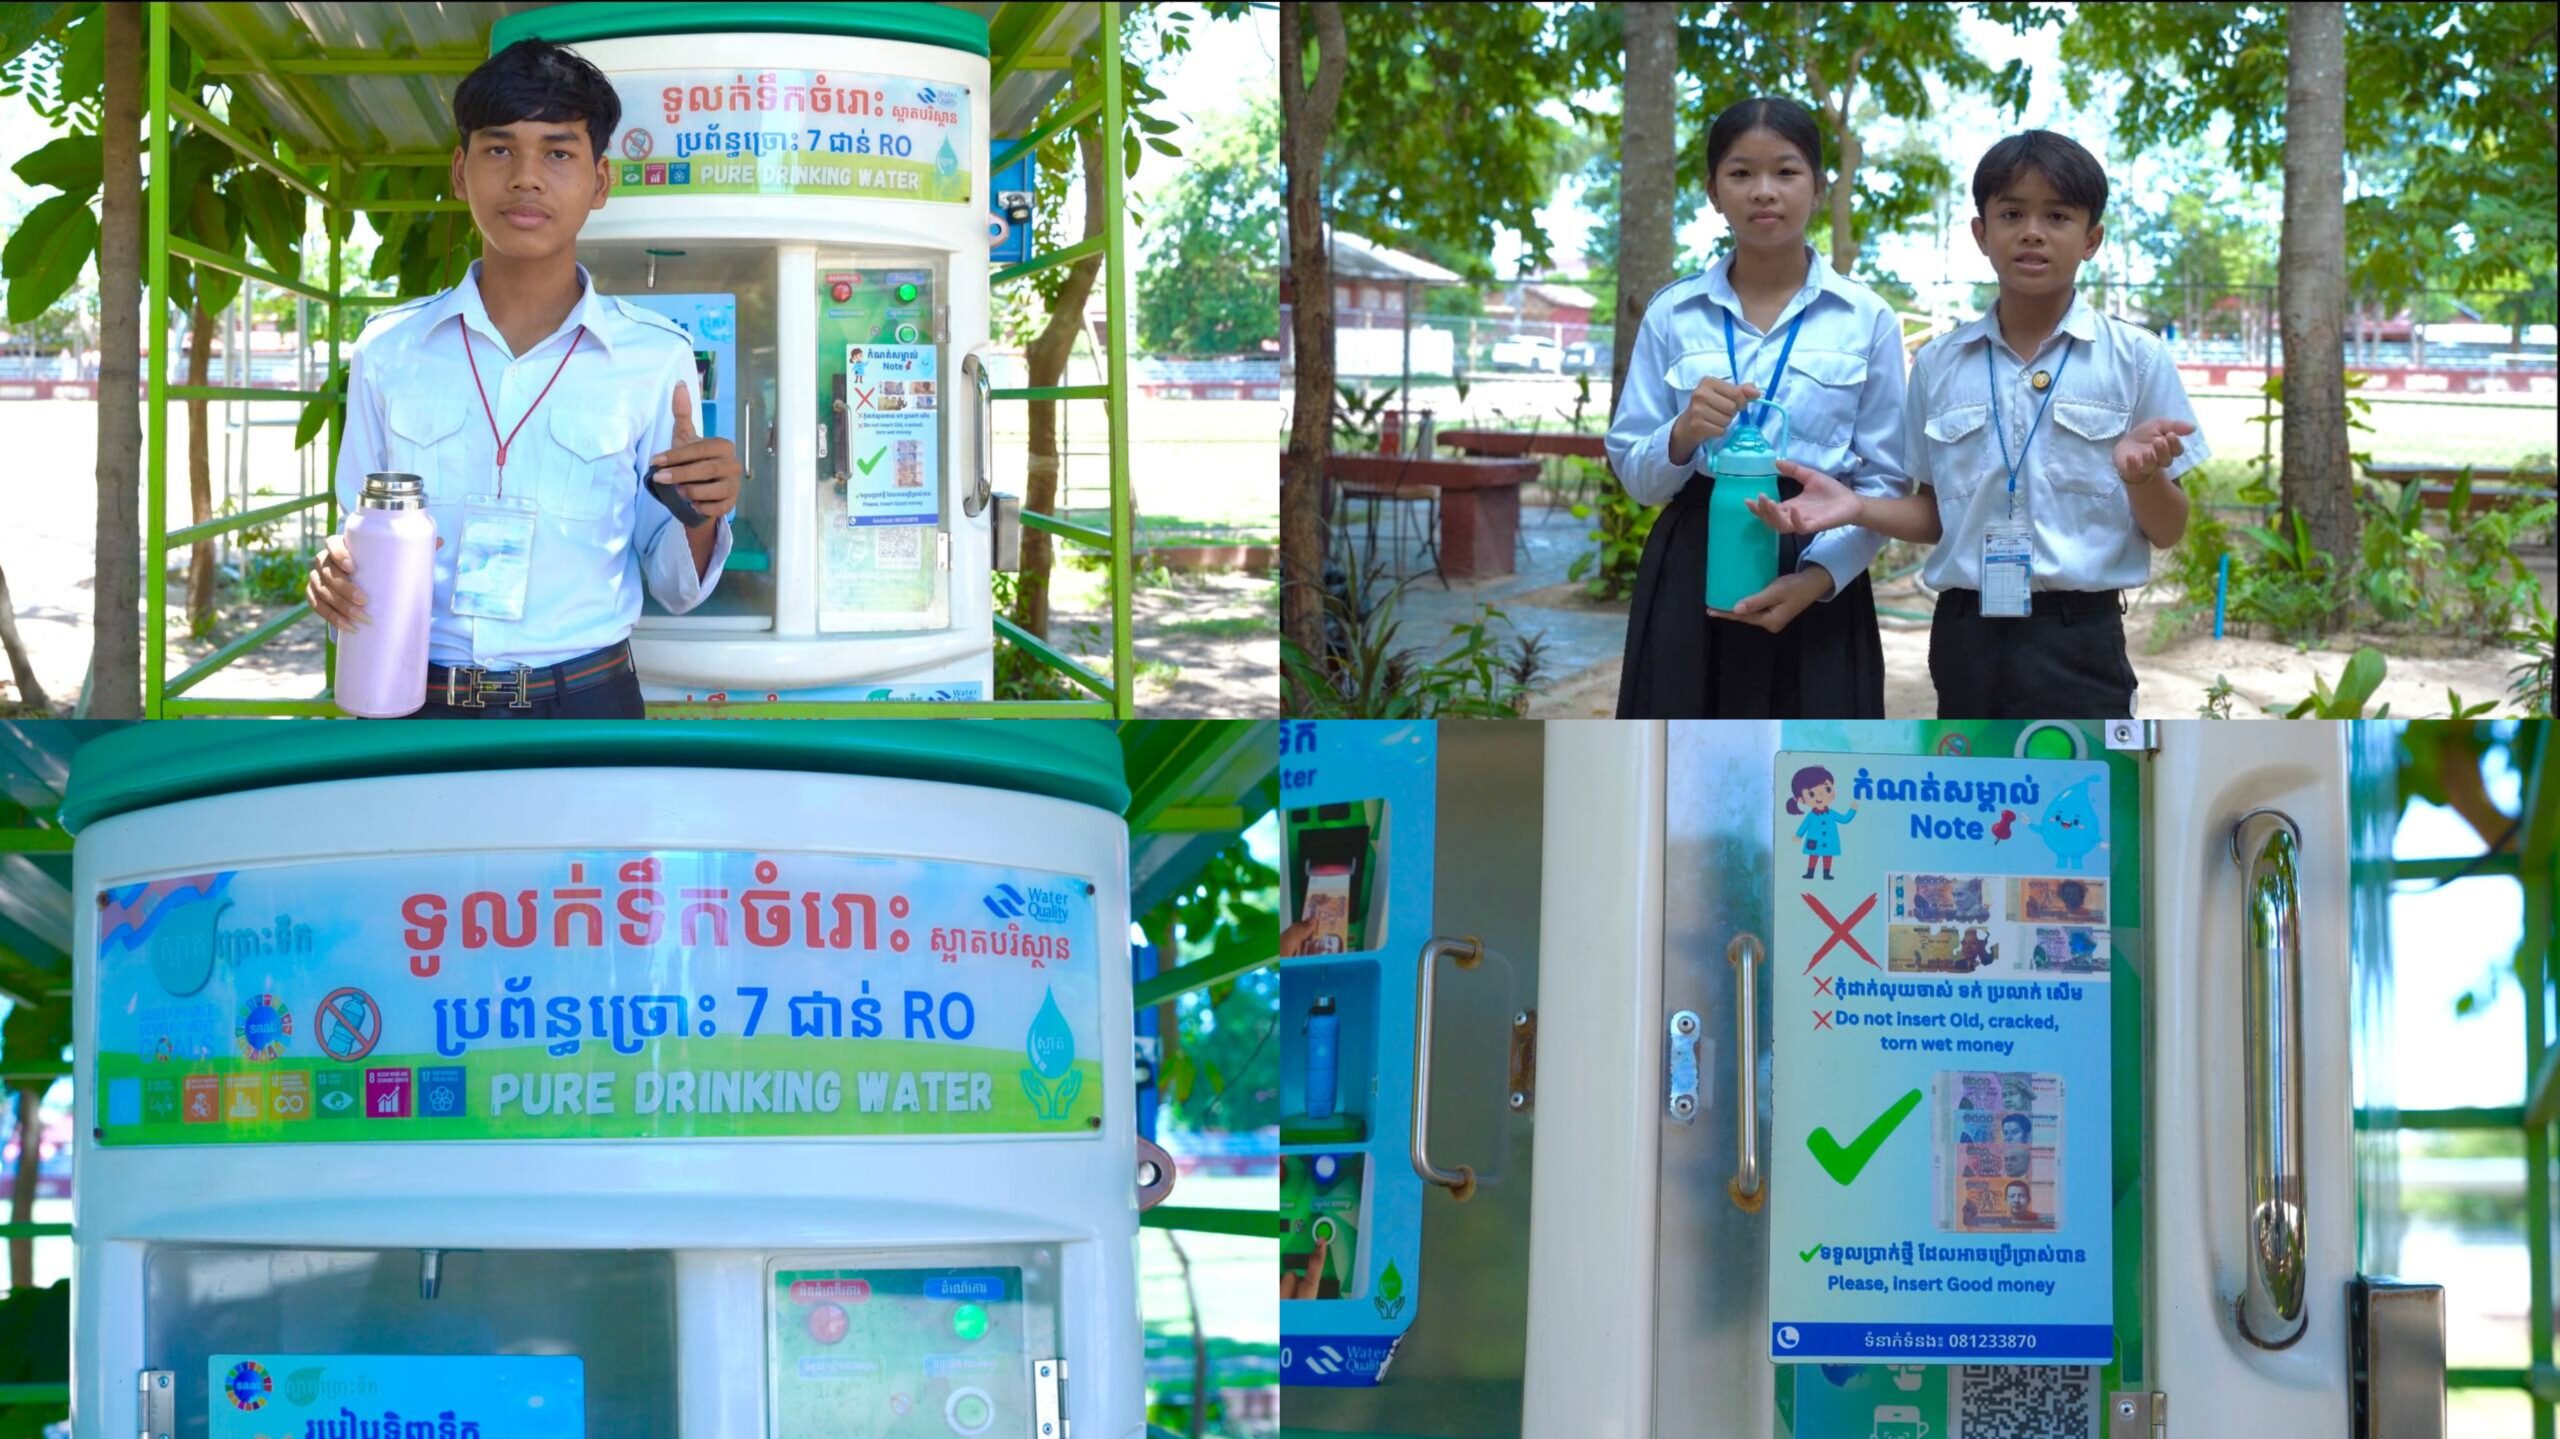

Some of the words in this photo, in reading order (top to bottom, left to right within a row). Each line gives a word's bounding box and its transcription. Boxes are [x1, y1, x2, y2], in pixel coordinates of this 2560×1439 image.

[662, 73, 884, 124] ទូលក់ទឹកចំរោះ
[676, 123, 798, 158] ប្រព័ន្ធច្រោះ
[807, 130, 822, 152] 7
[829, 128, 870, 154] ជាន់
[880, 133, 912, 157] RO
[701, 164, 754, 184] PURE
[763, 165, 851, 186] DRINKING
[858, 167, 919, 189] WATER
[882, 361, 903, 371] Note
[1852, 768, 2039, 813] កំណត់សម្គាល់
[1910, 814, 1984, 840] Note
[1027, 887, 1068, 905] Water
[401, 856, 911, 978] ទូលក់ទឹកចំរោះ
[1027, 902, 1069, 922] Quality
[929, 922, 1071, 969] ស្អាតបរិស្ថាន
[433, 975, 718, 1058] ប្រព័ន្ធច្រោះ
[736, 986, 769, 1038] 7
[788, 980, 883, 1038] ជាន់
[904, 990, 976, 1041] RO
[1835, 1010, 1859, 1026] Do
[1864, 1011, 1893, 1026] not
[1897, 1011, 1946, 1027] insert
[1950, 1013, 1985, 1031] Old,
[1988, 1014, 2060, 1032] cracked,
[1880, 1036, 1917, 1051] torn
[1921, 1037, 1953, 1051] wet
[1957, 1039, 2014, 1056] money
[490, 1071, 616, 1116] PURE
[635, 1069, 842, 1115] DRINKING
[857, 1071, 993, 1113] WATER
[1828, 1275, 1889, 1294] Please,
[1893, 1276, 1943, 1291] insert
[1947, 1277, 1993, 1292] Good
[1997, 1279, 2056, 1296] money
[1347, 1346, 1388, 1359] Water
[1949, 1334, 2037, 1349] 081233870
